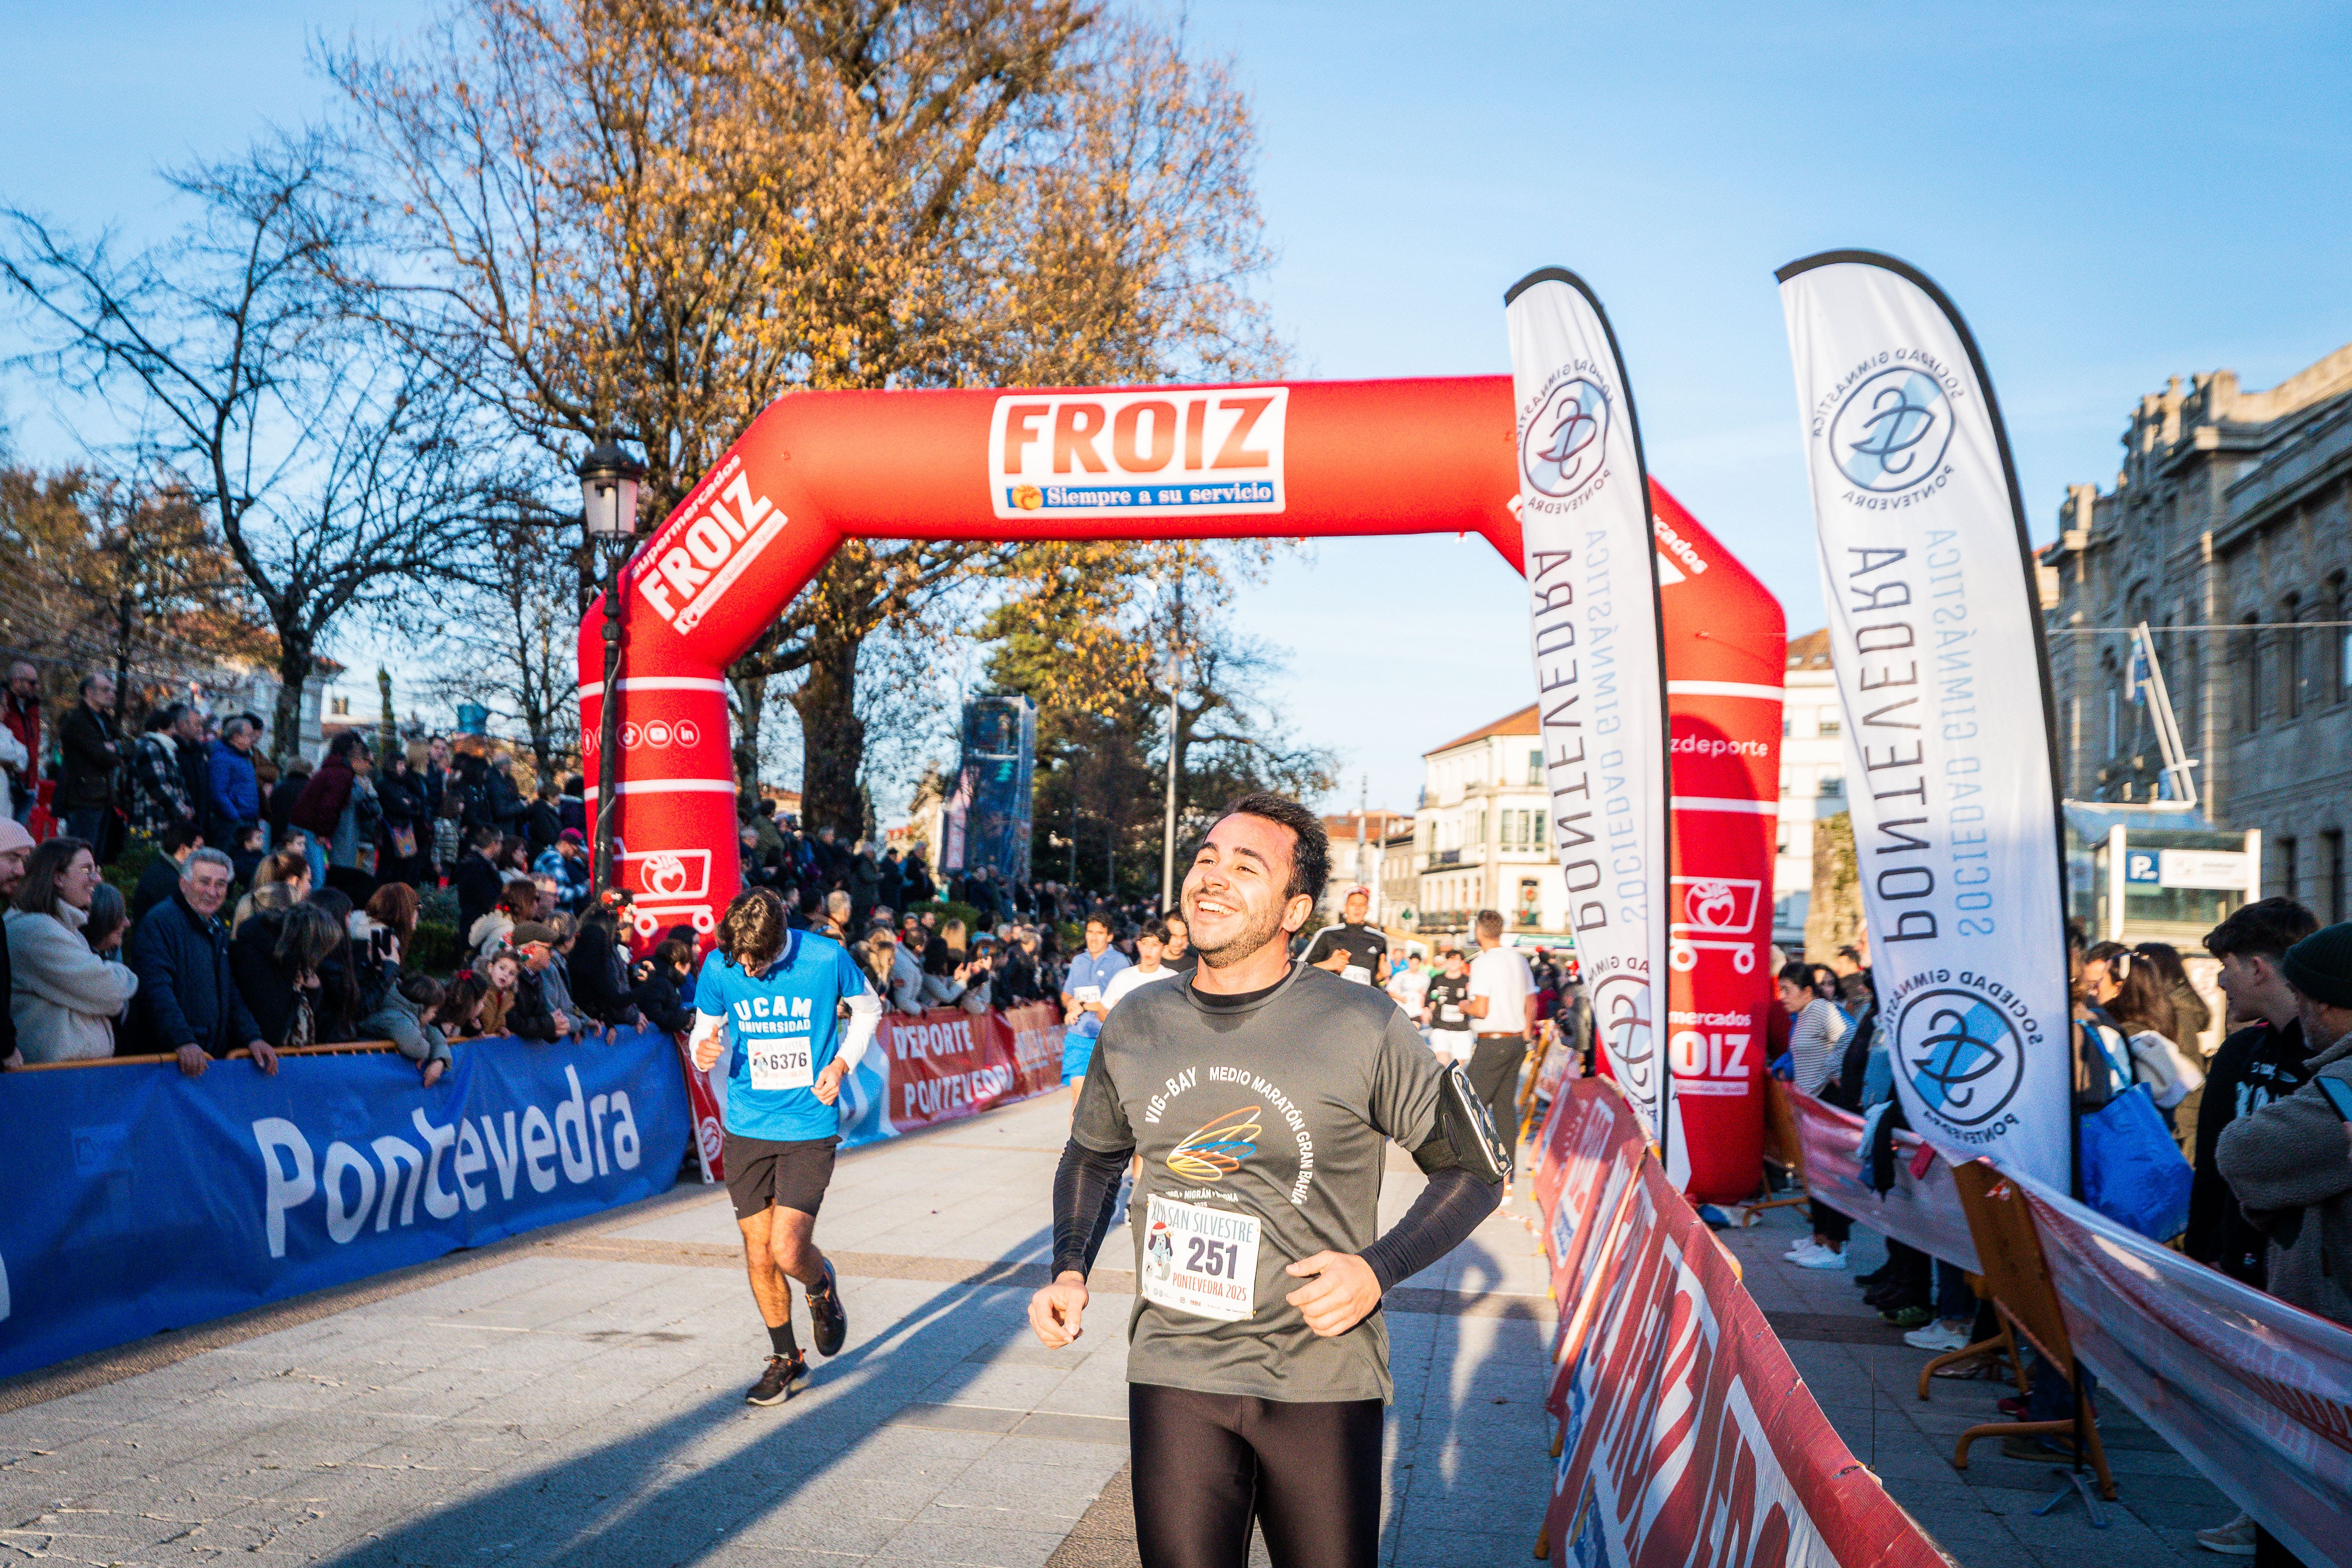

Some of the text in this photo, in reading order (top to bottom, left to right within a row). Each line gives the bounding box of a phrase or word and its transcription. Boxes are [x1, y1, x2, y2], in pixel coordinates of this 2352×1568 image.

[1004, 396, 1278, 474] FROIZ
[1047, 482, 1272, 506] Siempre a su servicio
[631, 454, 741, 580] supermercados
[638, 470, 773, 621] FROIZ
[2130, 856, 2151, 879] P
[733, 996, 812, 1021] UCAM
[738, 1018, 811, 1034] UNIVERSIDAD
[892, 1021, 974, 1060] DEPORTE
[771, 1052, 807, 1069] 6376
[1145, 1066, 1314, 1205] VIG-BAY MEDIO MARATÓN GRAN BAHÍA
[252, 1063, 641, 1258] Pontevedra
[1184, 1188, 1212, 1199] NIGRÁN
[1168, 1207, 1190, 1230] SAN
[1193, 1212, 1253, 1243] SILVESTRE
[1187, 1236, 1238, 1279] 251
[1173, 1272, 1247, 1301] PONTEVEDRA 2025
